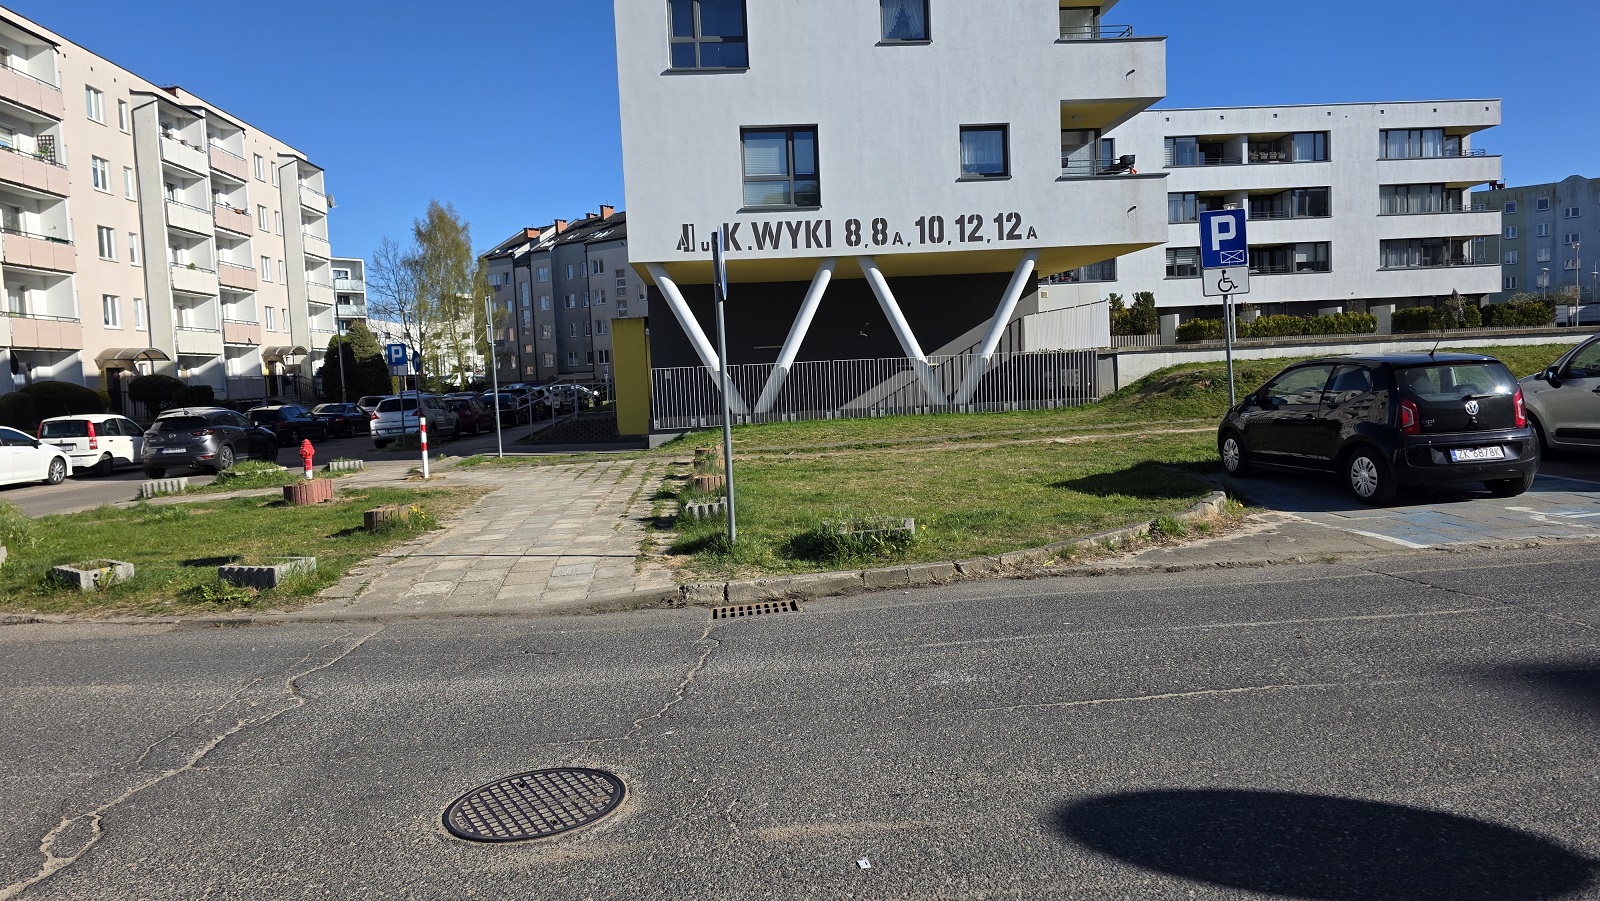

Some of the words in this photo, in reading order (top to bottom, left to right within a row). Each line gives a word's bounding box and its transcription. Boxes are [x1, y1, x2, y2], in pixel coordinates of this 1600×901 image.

[1210, 215, 1236, 250] P
[391, 346, 402, 362] P
[1458, 449, 1470, 459] ZK
